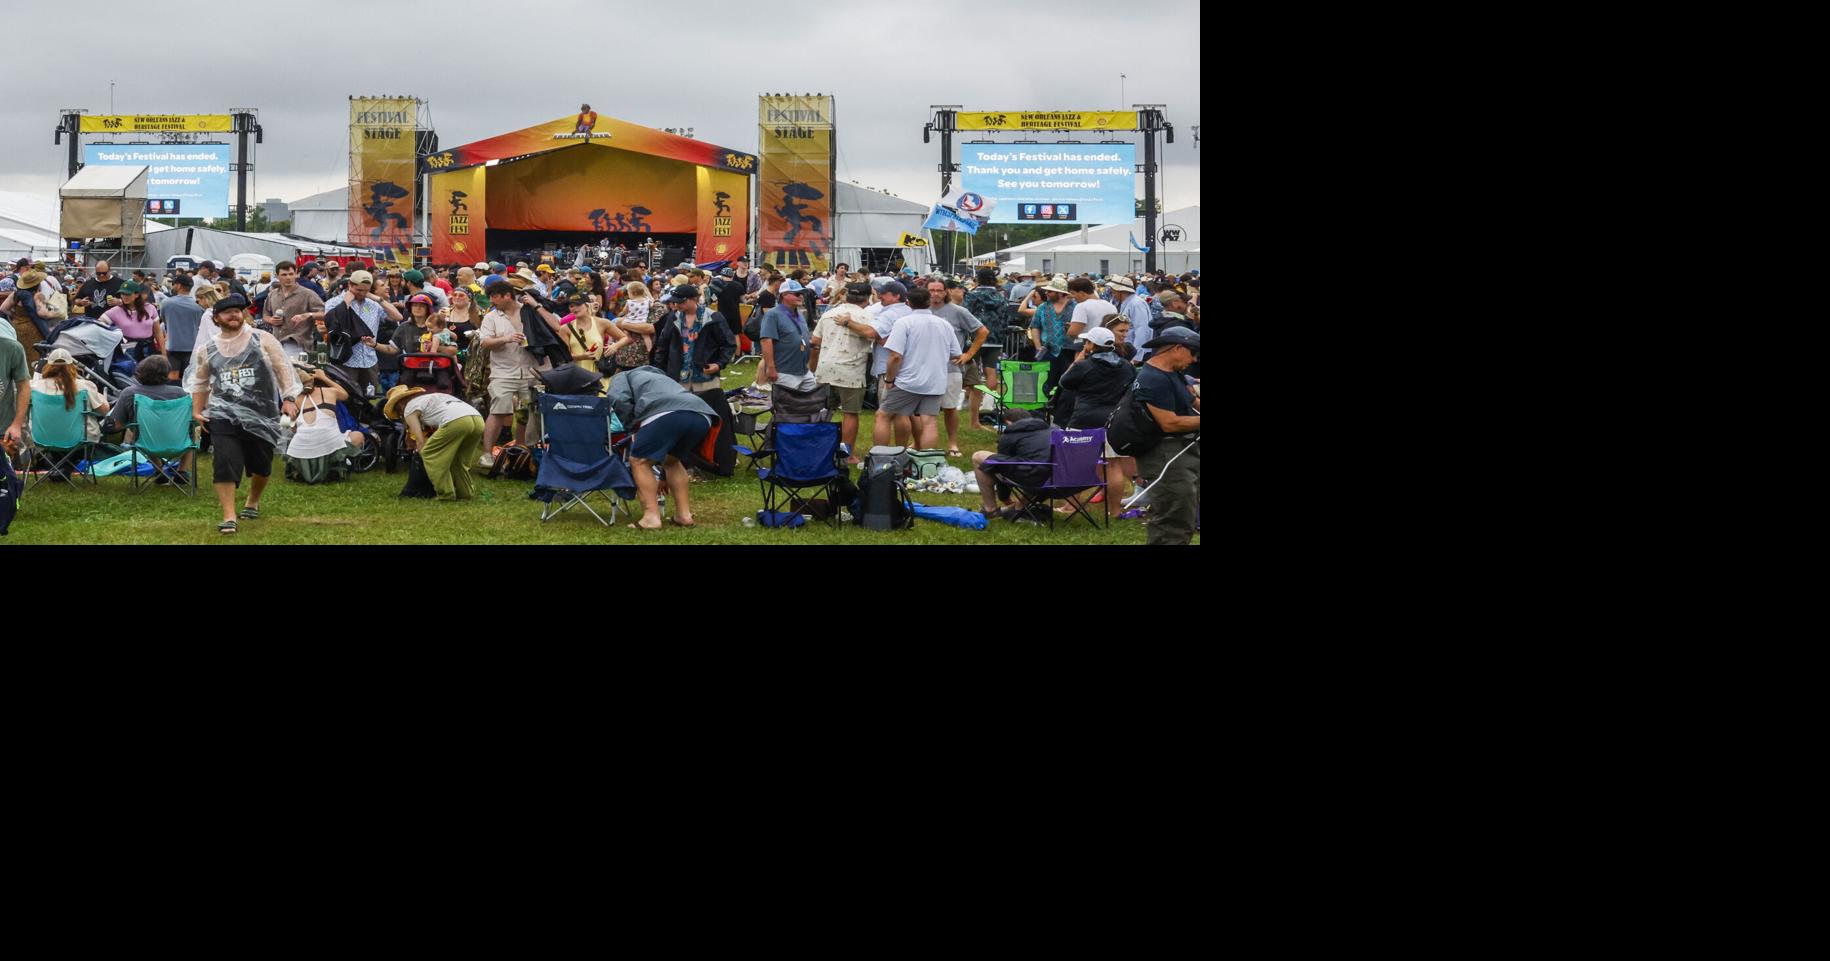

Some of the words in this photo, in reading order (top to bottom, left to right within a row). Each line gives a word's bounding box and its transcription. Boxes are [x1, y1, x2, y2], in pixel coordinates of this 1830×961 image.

[357, 111, 408, 124] FESTIVAL
[768, 109, 823, 122] FESTIVAL
[364, 127, 401, 140] STAGE
[775, 126, 815, 139] STAGE
[98, 152, 132, 162] Today's
[133, 152, 169, 160] Festival
[170, 152, 186, 160] has
[187, 152, 218, 160] ended.
[977, 152, 1017, 162] Today's
[1019, 152, 1062, 161] Festival
[1064, 152, 1082, 161] has
[1083, 152, 1121, 161] ended.
[156, 166, 170, 174] get
[171, 165, 197, 173] home
[198, 165, 226, 174] safely.
[967, 165, 999, 174] Thank
[1001, 167, 1021, 176] you
[1022, 165, 1042, 174] and
[1043, 167, 1063, 176] get
[1064, 165, 1095, 174] home
[1096, 165, 1132, 176] safely.
[997, 179, 1017, 188] See
[1019, 181, 1039, 190] you
[1041, 179, 1100, 189] tomorrow!
[450, 216, 468, 224] JAZZ
[714, 218, 731, 226] JAZZ
[450, 225, 468, 234] FEST
[238, 367, 255, 377] FEST
